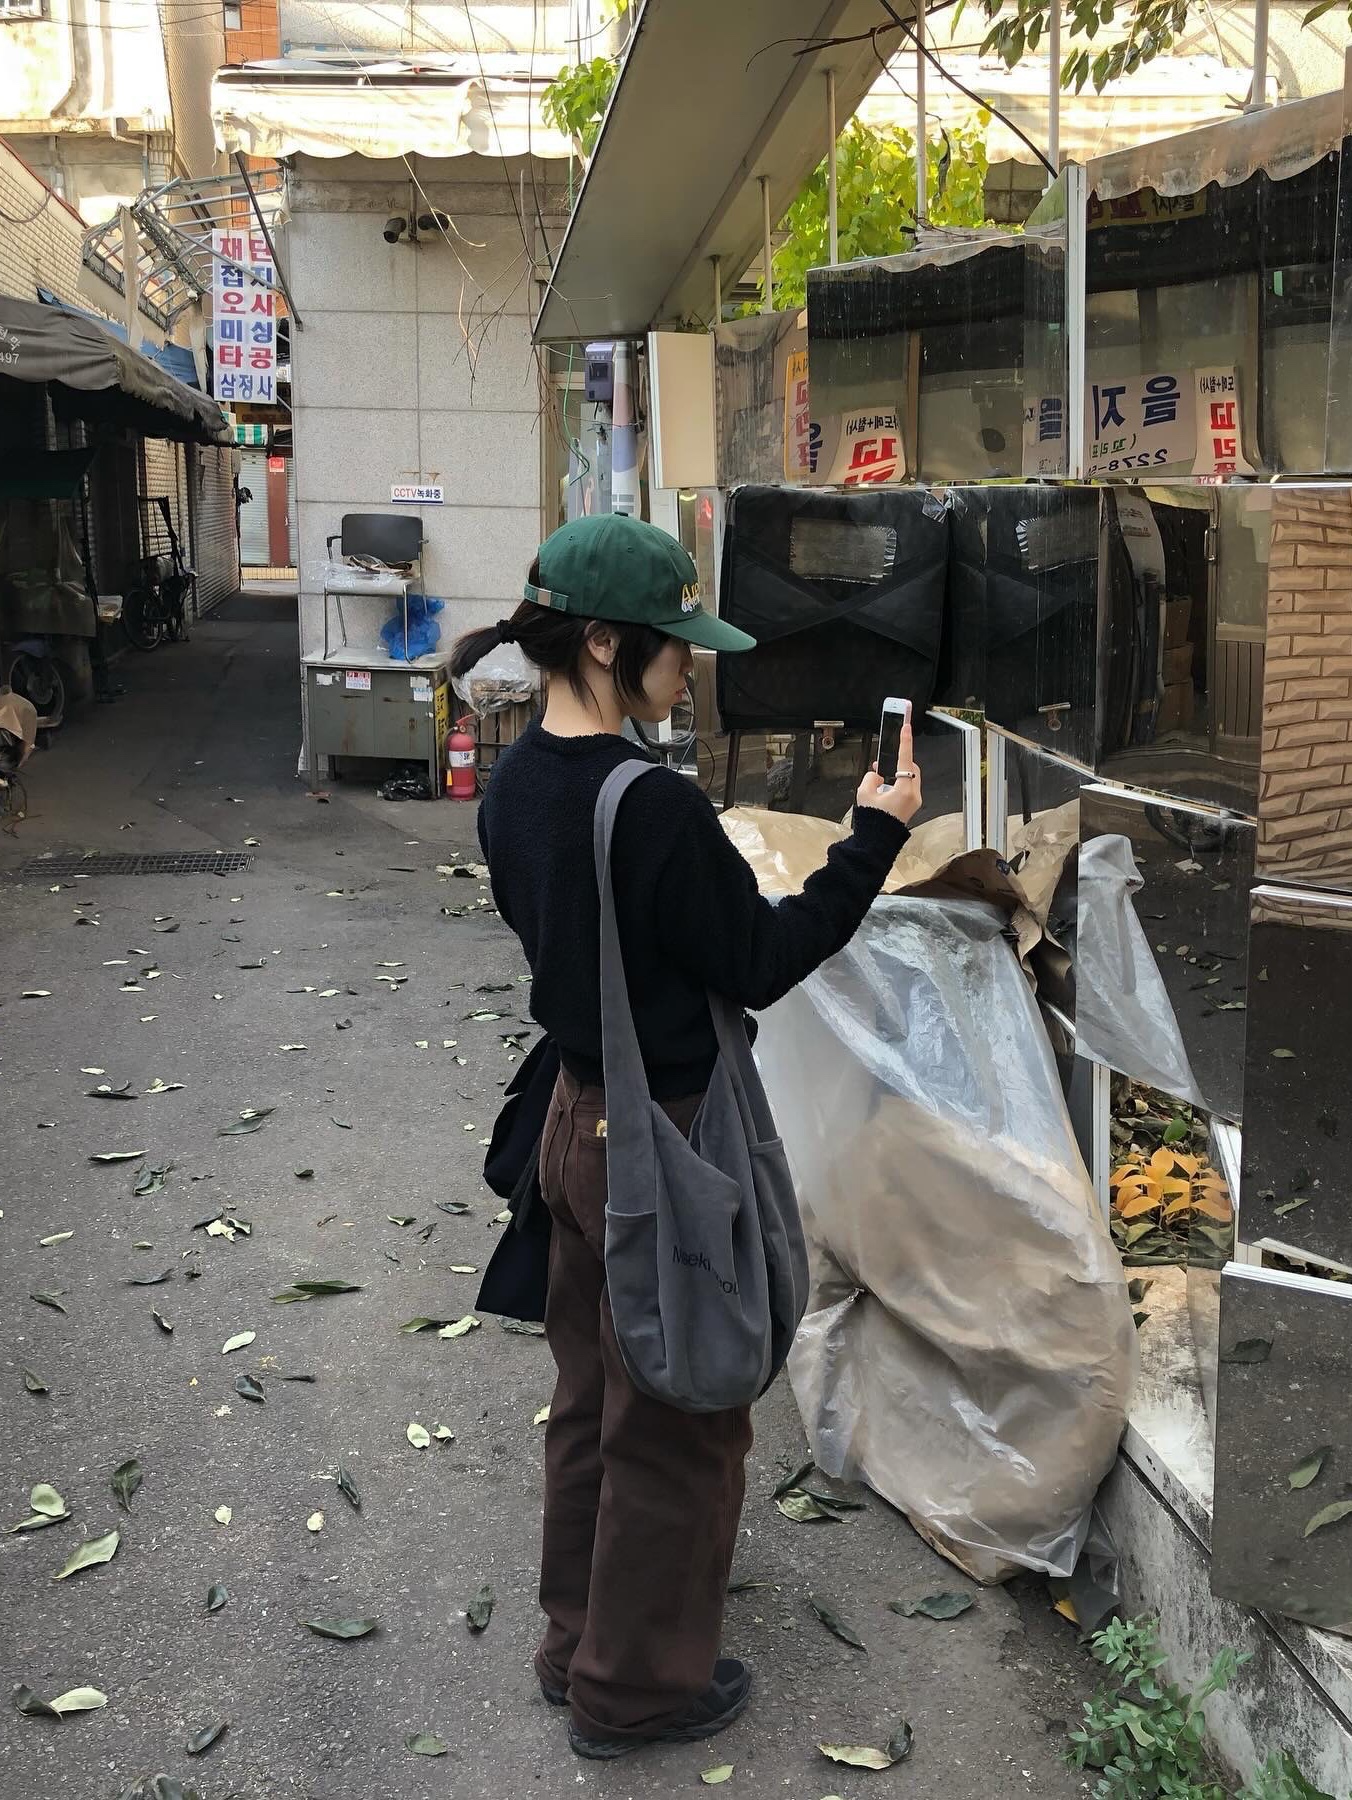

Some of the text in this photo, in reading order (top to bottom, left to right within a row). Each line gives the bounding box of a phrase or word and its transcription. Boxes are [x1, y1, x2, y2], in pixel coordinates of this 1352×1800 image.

[219, 237, 273, 262] 재단
[220, 291, 273, 317] 오시
[220, 319, 273, 344] 미싱
[219, 345, 274, 369] 타공
[220, 373, 273, 401] 삼정사
